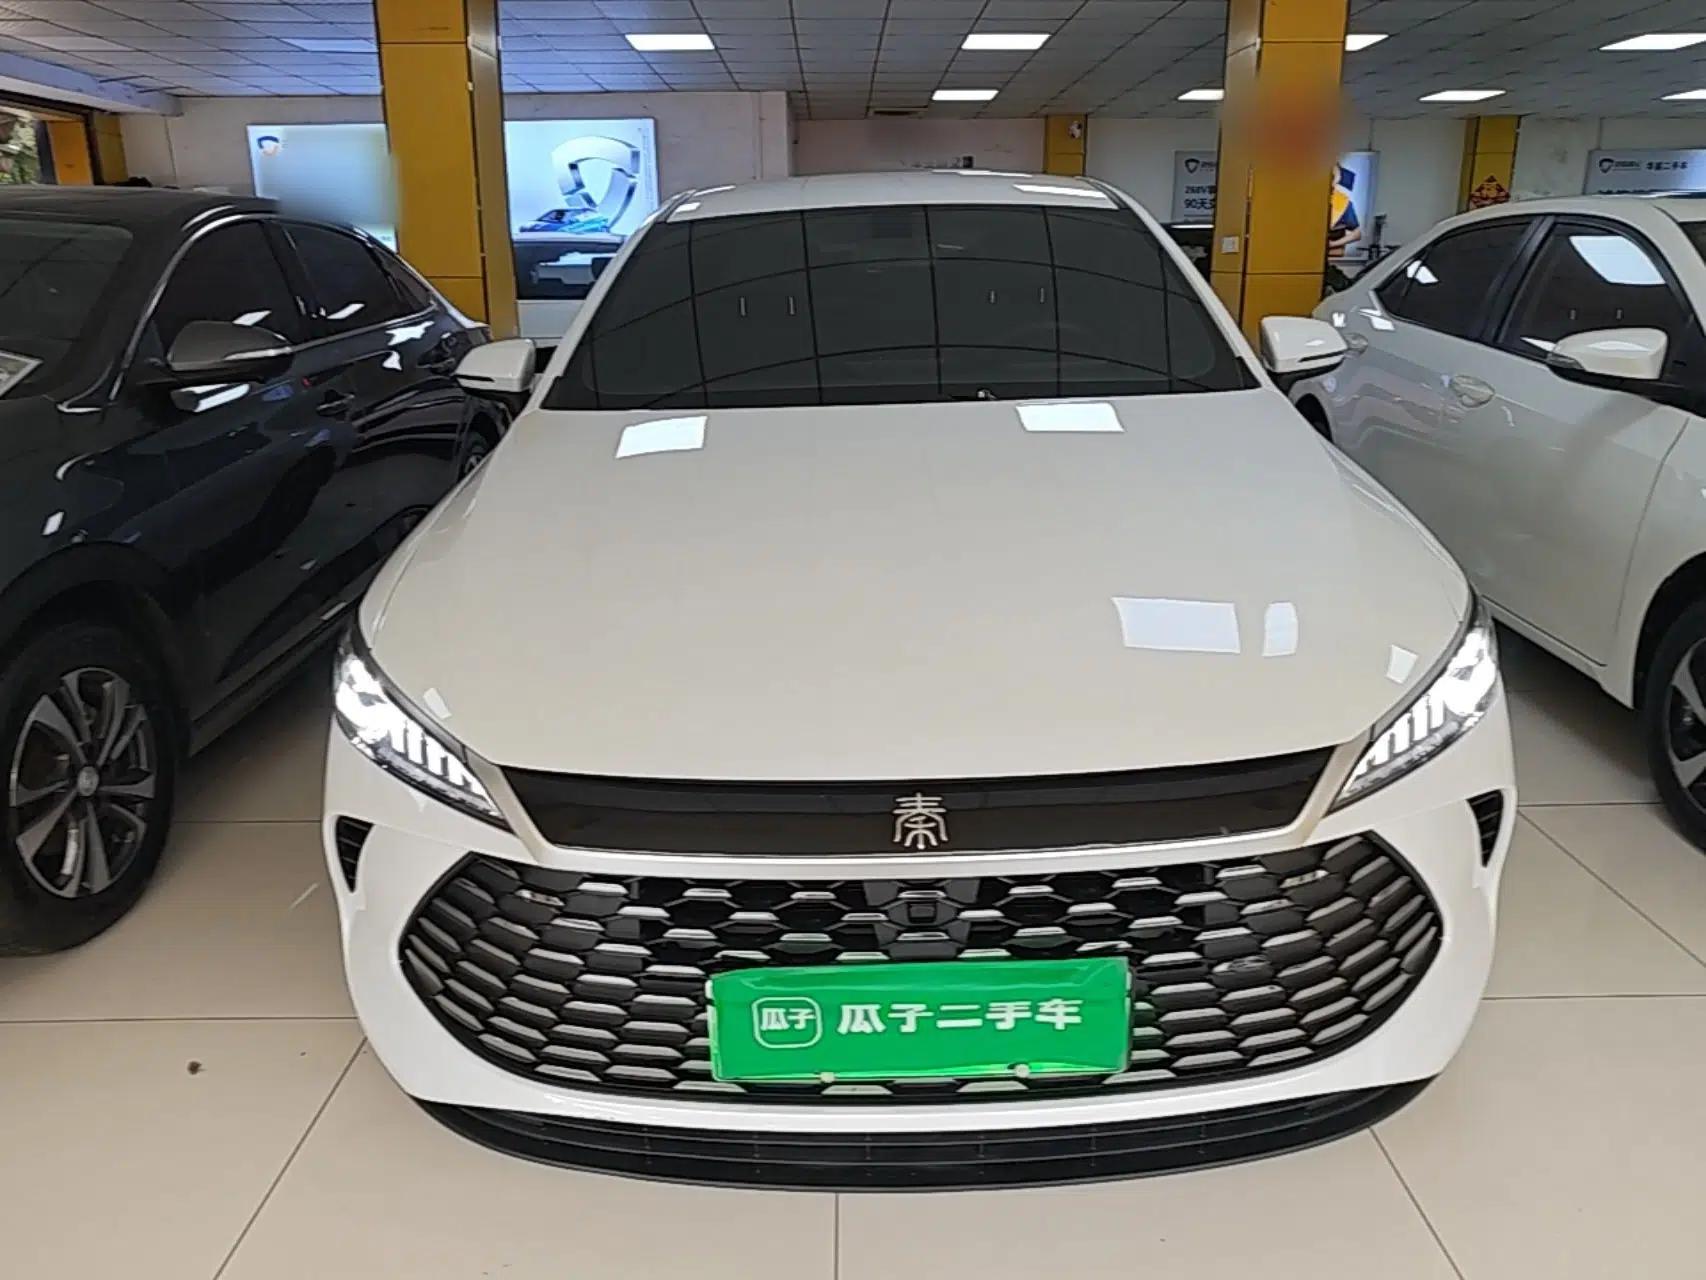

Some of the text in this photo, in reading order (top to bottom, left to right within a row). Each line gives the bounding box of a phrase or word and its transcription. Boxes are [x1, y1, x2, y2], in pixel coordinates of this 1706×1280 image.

[893, 792, 948, 849] 秦
[760, 1007, 816, 1031] 瓜子
[837, 998, 1083, 1034] 瓜子二手车
